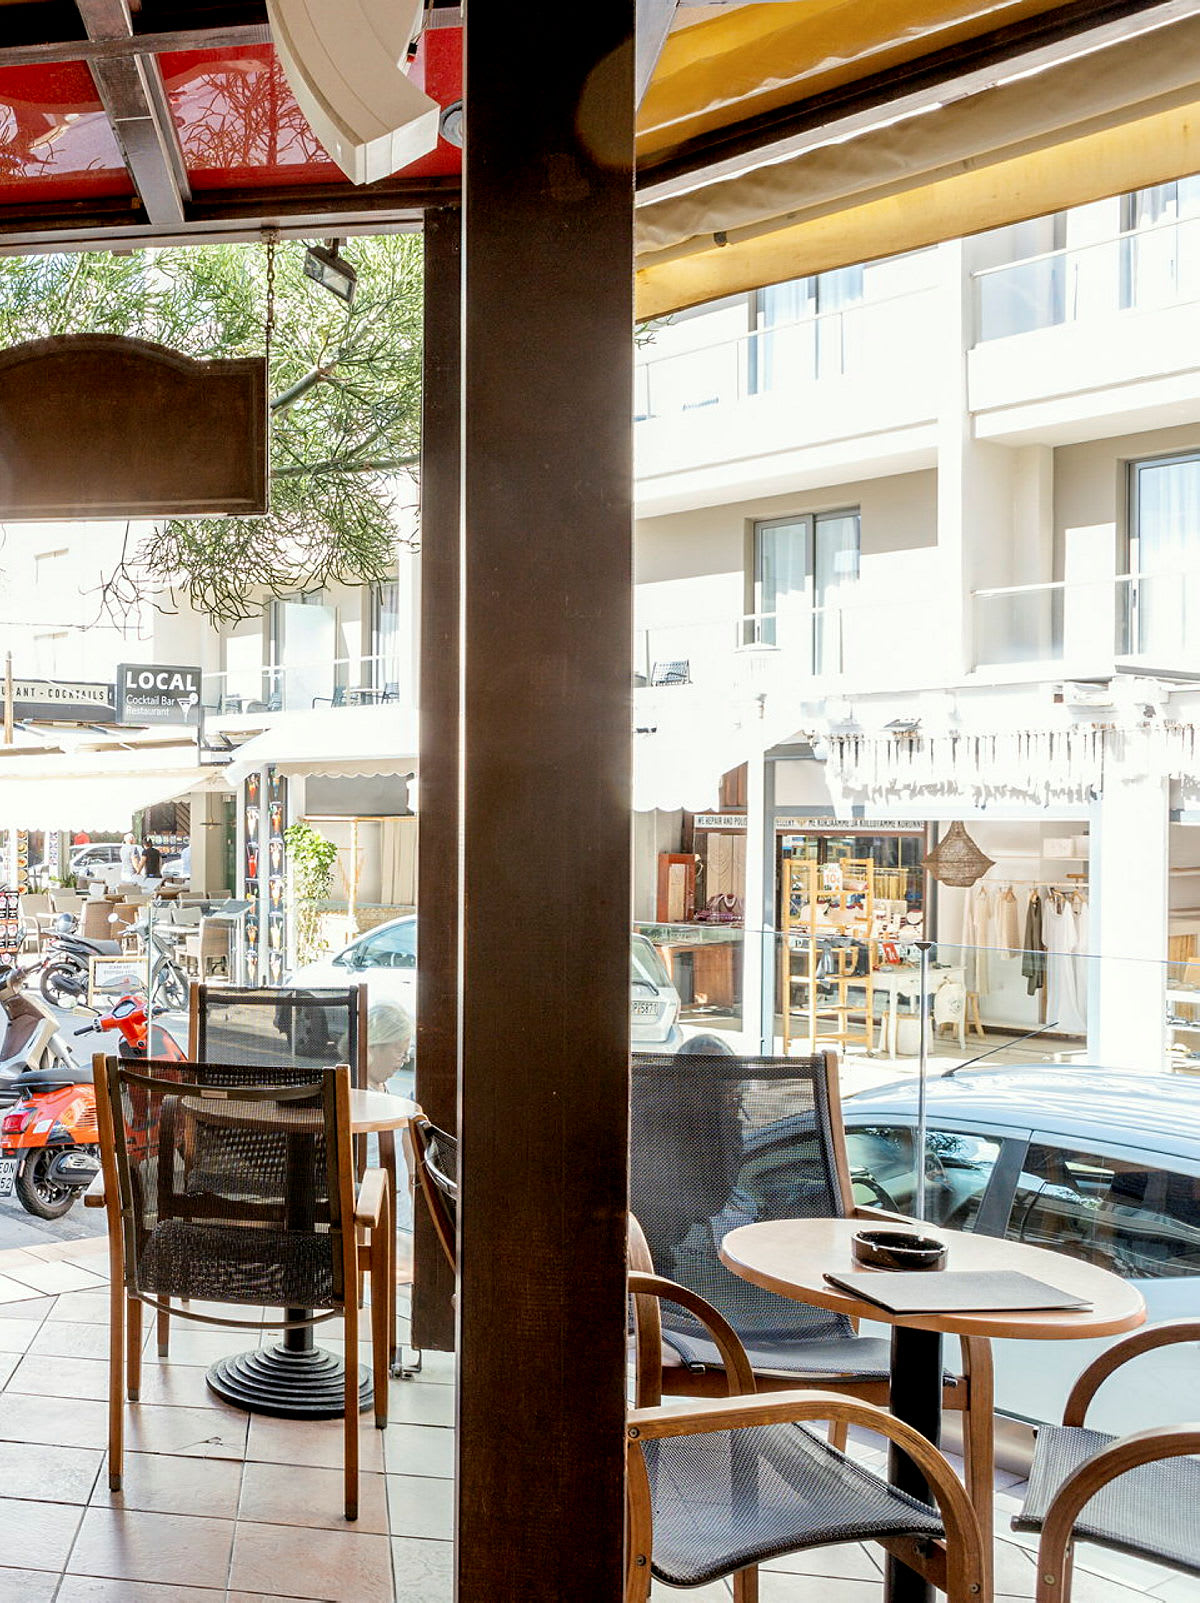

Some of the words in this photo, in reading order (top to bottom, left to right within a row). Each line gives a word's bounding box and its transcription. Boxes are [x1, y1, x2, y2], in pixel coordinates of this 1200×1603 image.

[126, 671, 197, 691] LOCAL
[126, 694, 160, 705] Cocktail
[161, 696, 175, 706] Bar
